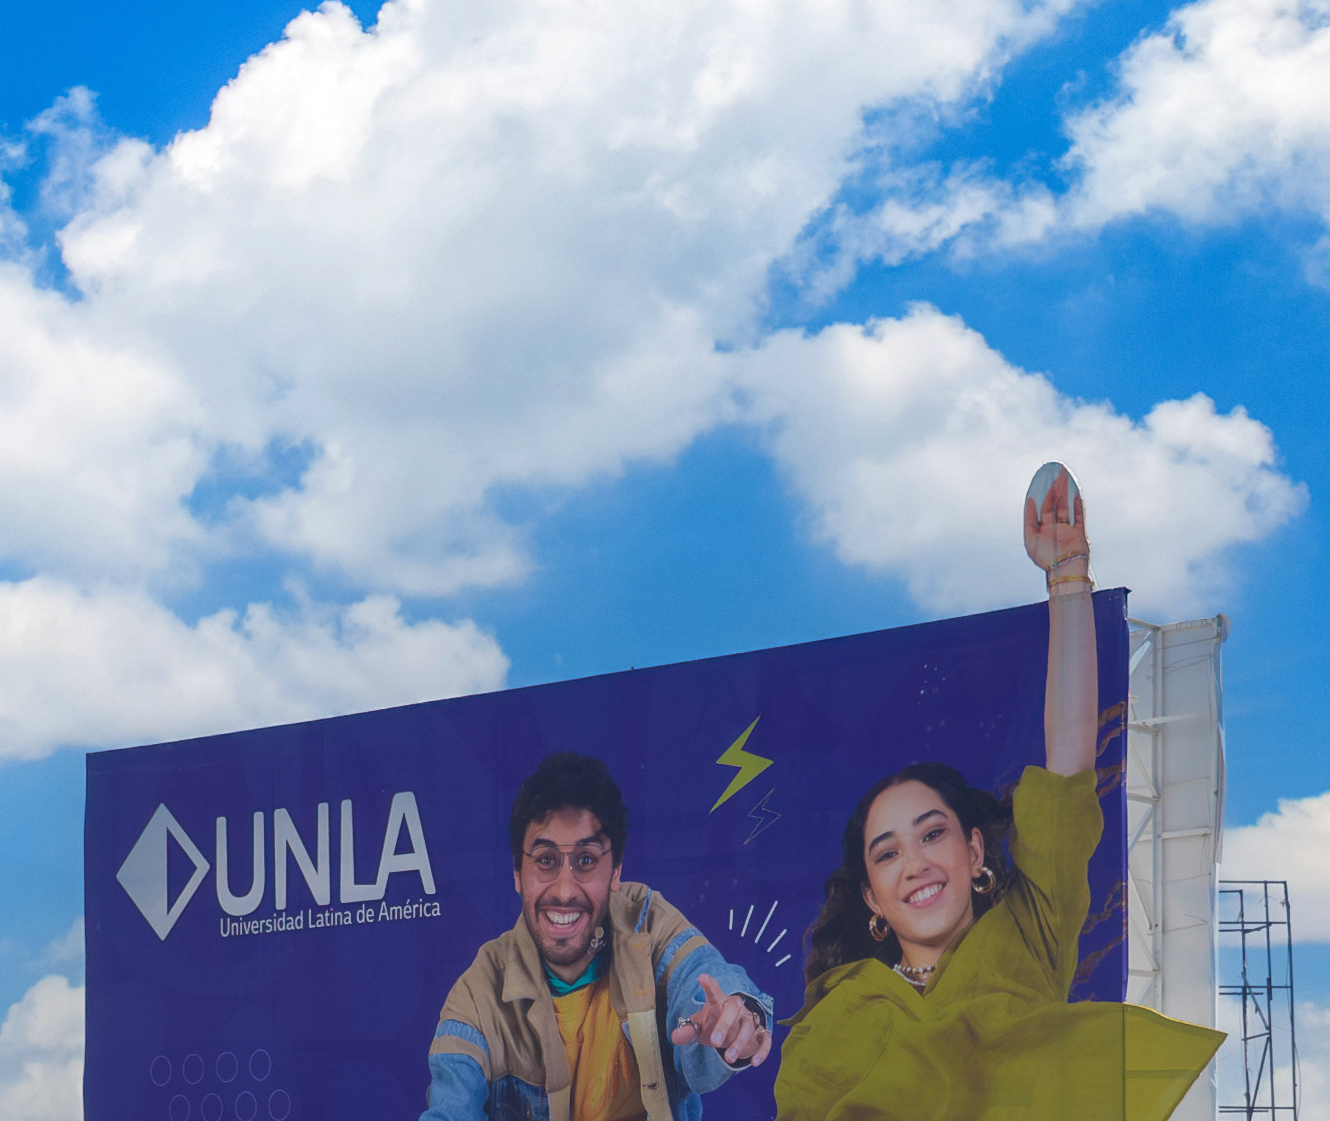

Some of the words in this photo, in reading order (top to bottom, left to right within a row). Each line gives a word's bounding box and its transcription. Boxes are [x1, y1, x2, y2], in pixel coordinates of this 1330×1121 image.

[215, 791, 436, 916] UNLA
[220, 910, 304, 938] Universidad
[308, 909, 352, 929] Latina
[356, 904, 375, 923] de
[378, 899, 441, 922] América
